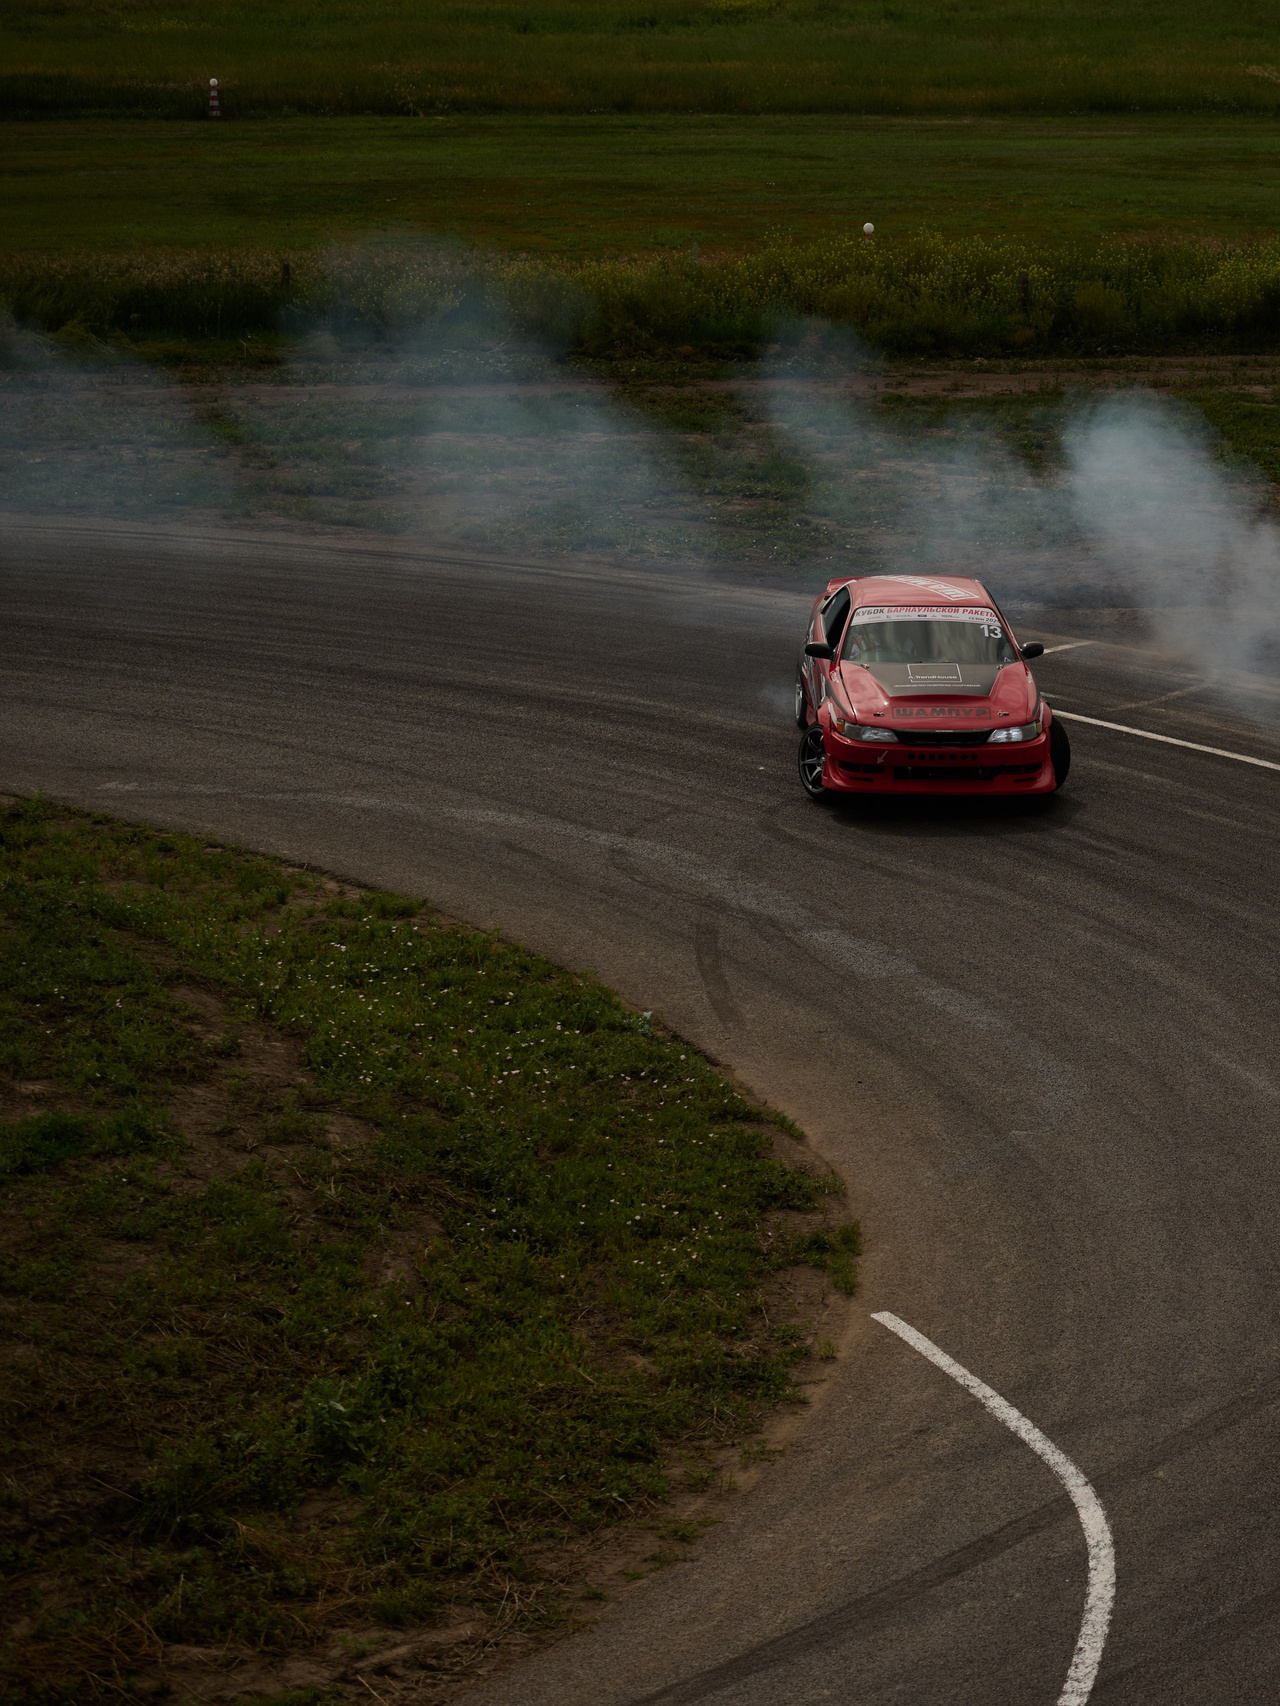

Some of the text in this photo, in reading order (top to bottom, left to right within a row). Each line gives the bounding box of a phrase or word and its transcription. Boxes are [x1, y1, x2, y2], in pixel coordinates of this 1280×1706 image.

[855, 608, 884, 618] КУБОК
[887, 606, 960, 614] БАРНАУЛЬСКОЙ
[980, 624, 1002, 639] 13
[896, 708, 987, 717] ШАМПУР
